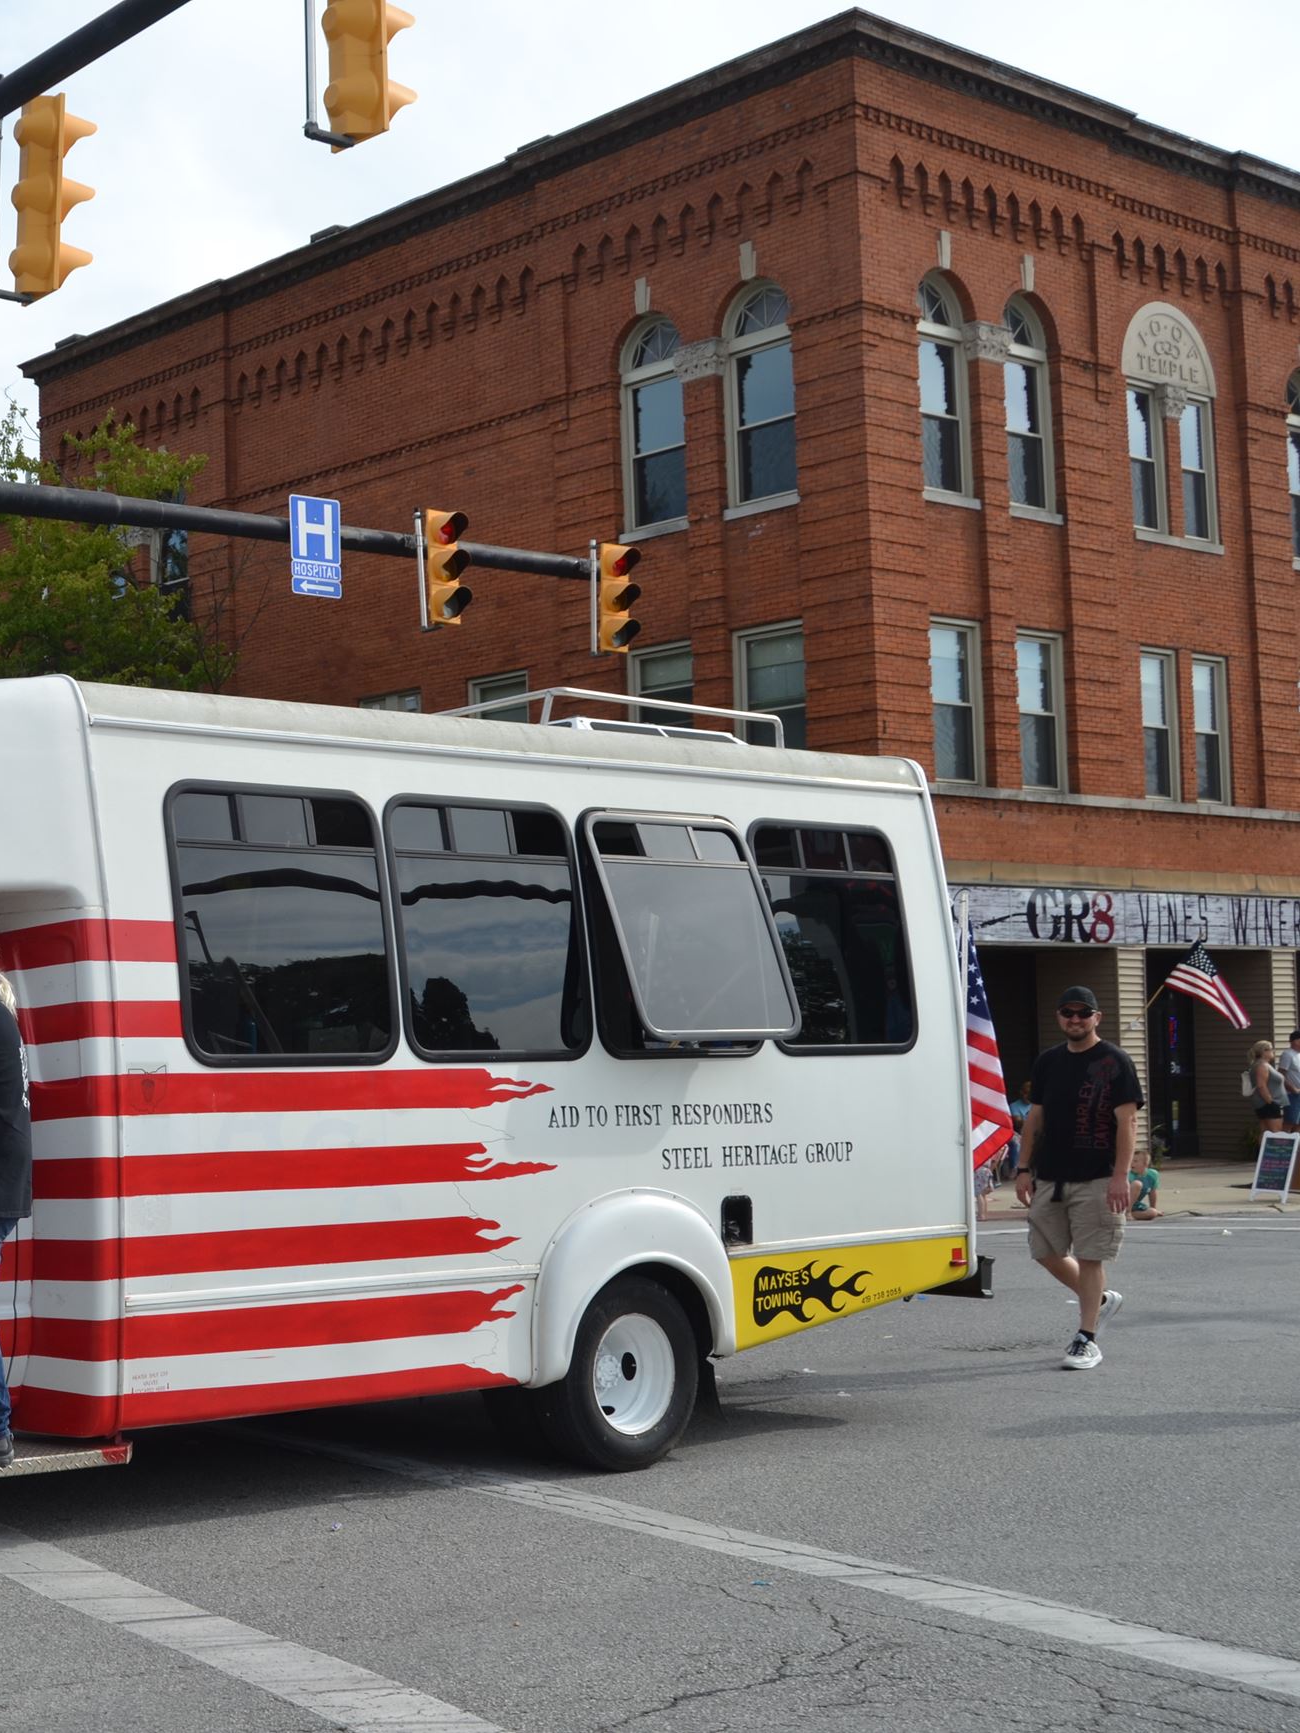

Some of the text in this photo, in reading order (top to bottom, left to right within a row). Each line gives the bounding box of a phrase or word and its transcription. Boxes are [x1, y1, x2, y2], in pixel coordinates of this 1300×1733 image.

[1136, 352, 1199, 385] TEMPLE
[297, 500, 333, 560] H
[294, 563, 338, 580] HOSPITAL
[1138, 894, 1208, 944] VINES
[548, 1102, 773, 1128] AID TO FIRST RESPONDERS
[1076, 1080, 1095, 1137] HARLEY
[662, 1141, 853, 1170] STEEL HERITAGE GROUP
[756, 1290, 802, 1312] TOWING
